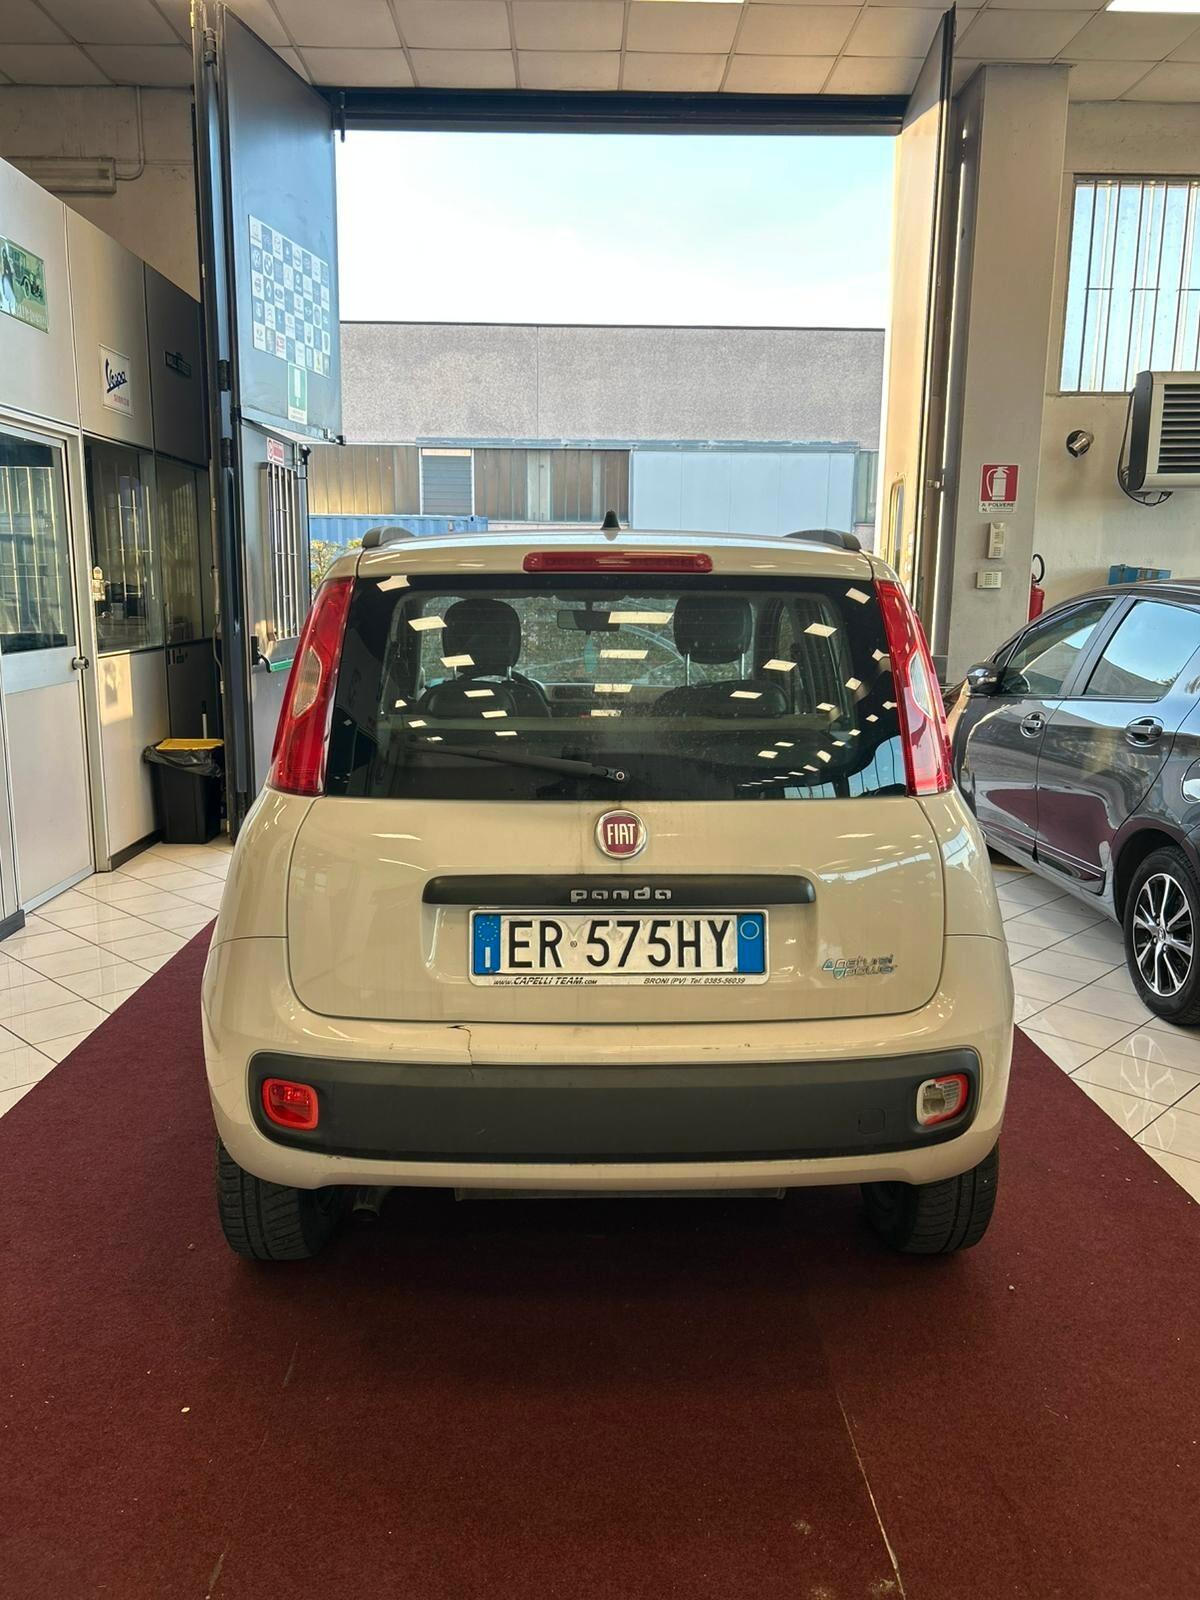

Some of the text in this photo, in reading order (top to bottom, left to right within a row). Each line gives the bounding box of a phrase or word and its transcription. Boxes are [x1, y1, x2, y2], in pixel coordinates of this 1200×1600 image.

[105, 358, 128, 393] Vespa
[607, 823, 636, 845] FIAT
[570, 886, 672, 903] panda
[508, 920, 730, 968] ER 575HY
[643, 977, 670, 985] BRONI
[670, 977, 687, 985] (PV)
